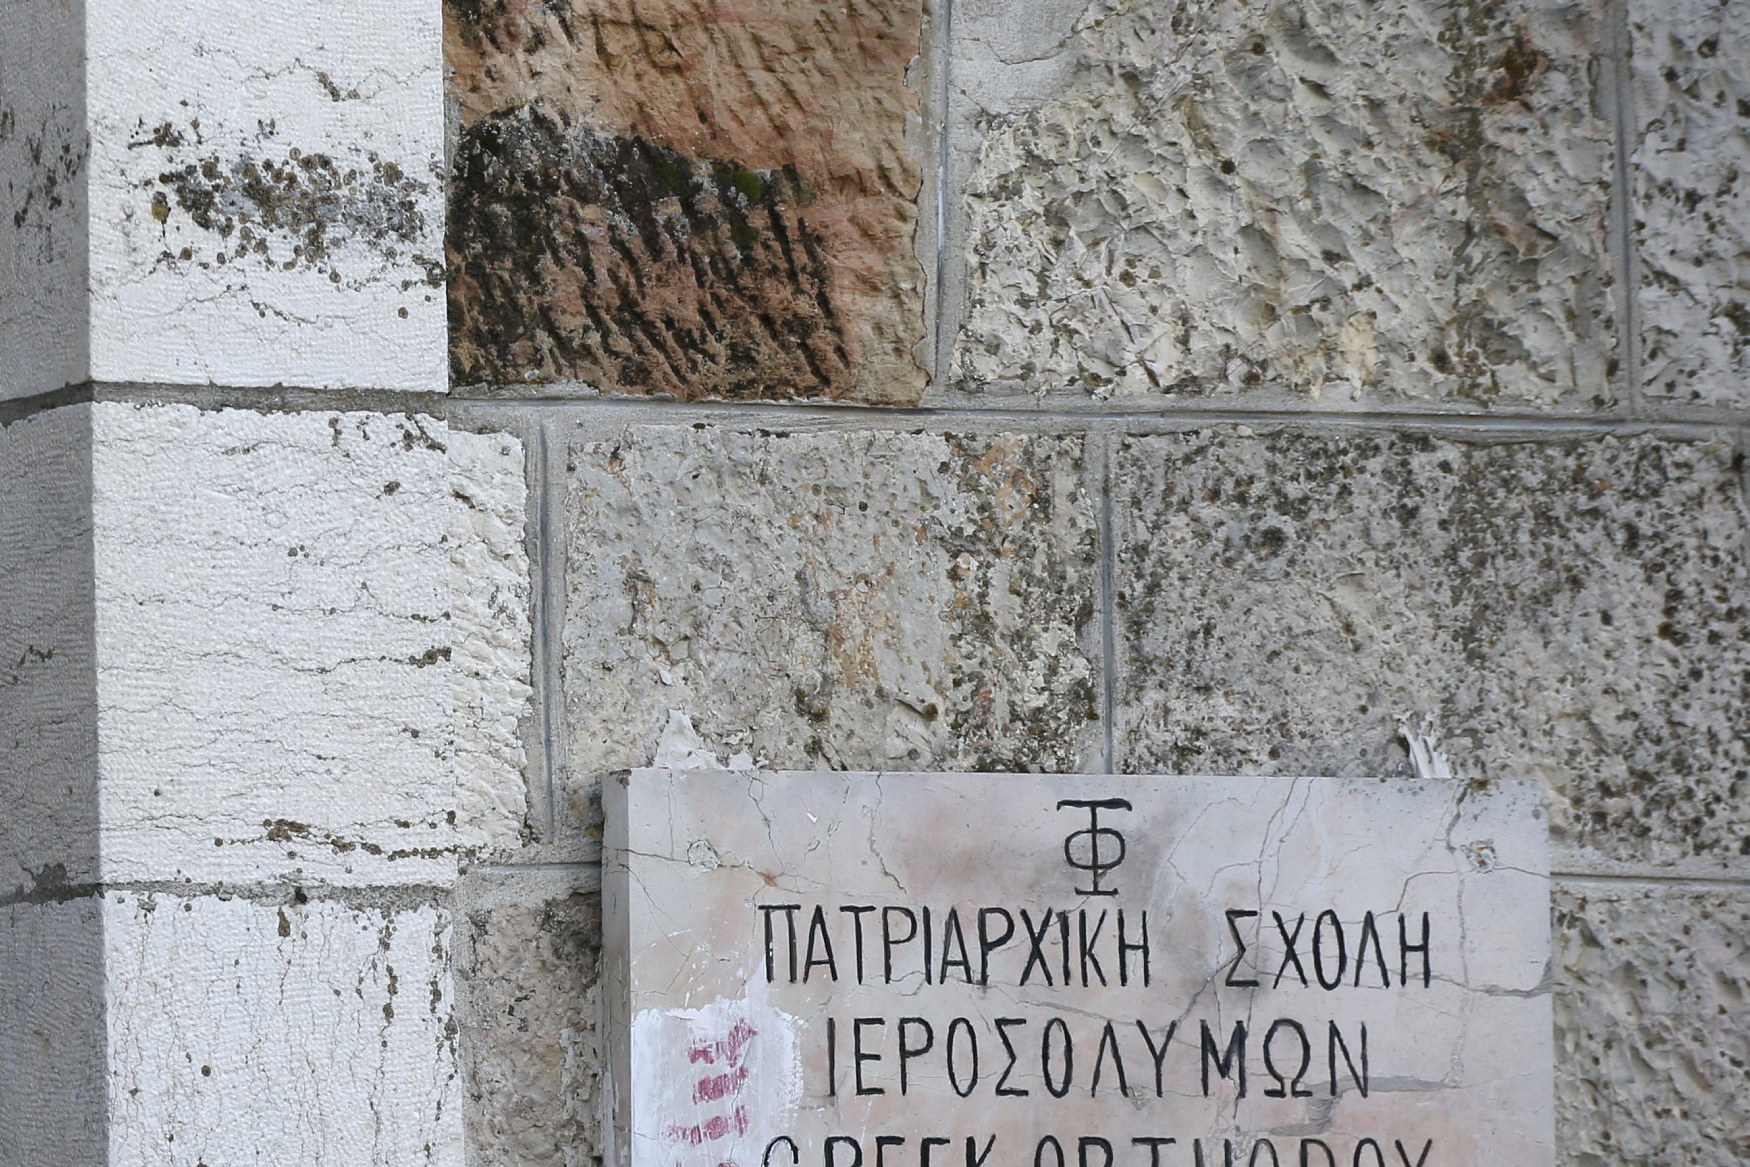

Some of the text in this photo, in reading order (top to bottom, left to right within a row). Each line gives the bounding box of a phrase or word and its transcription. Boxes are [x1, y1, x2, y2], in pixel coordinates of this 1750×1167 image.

[758, 903, 1432, 991] ΠΑΤΡΙΑΡΧΙΚΗ ΣΧΟΛΗ
[825, 1016, 1370, 1100] ΙΕΡΟΣΟΛΥΜΩΝ
